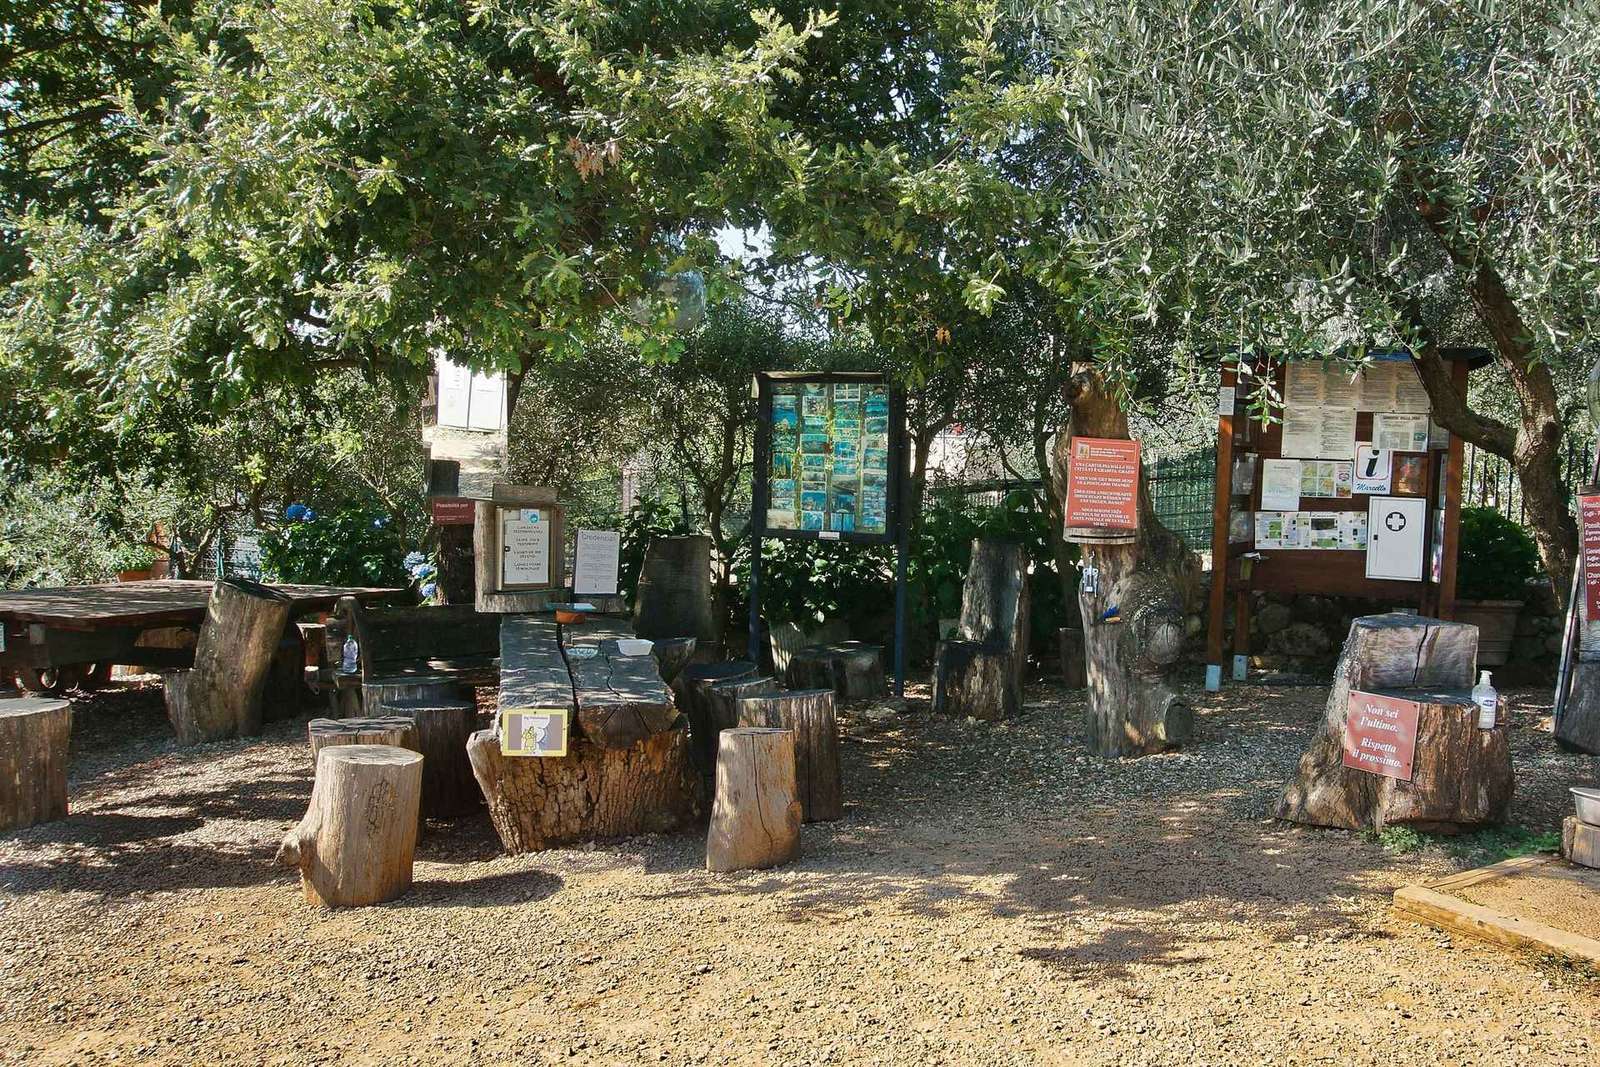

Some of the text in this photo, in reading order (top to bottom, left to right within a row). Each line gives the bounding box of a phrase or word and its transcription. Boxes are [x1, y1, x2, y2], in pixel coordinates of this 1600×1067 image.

[1356, 483, 1386, 491] Marcello
[1364, 703, 1399, 719] Non sei
[1361, 737, 1397, 753] Rispetta
[1352, 748, 1402, 768] il prossimo.
